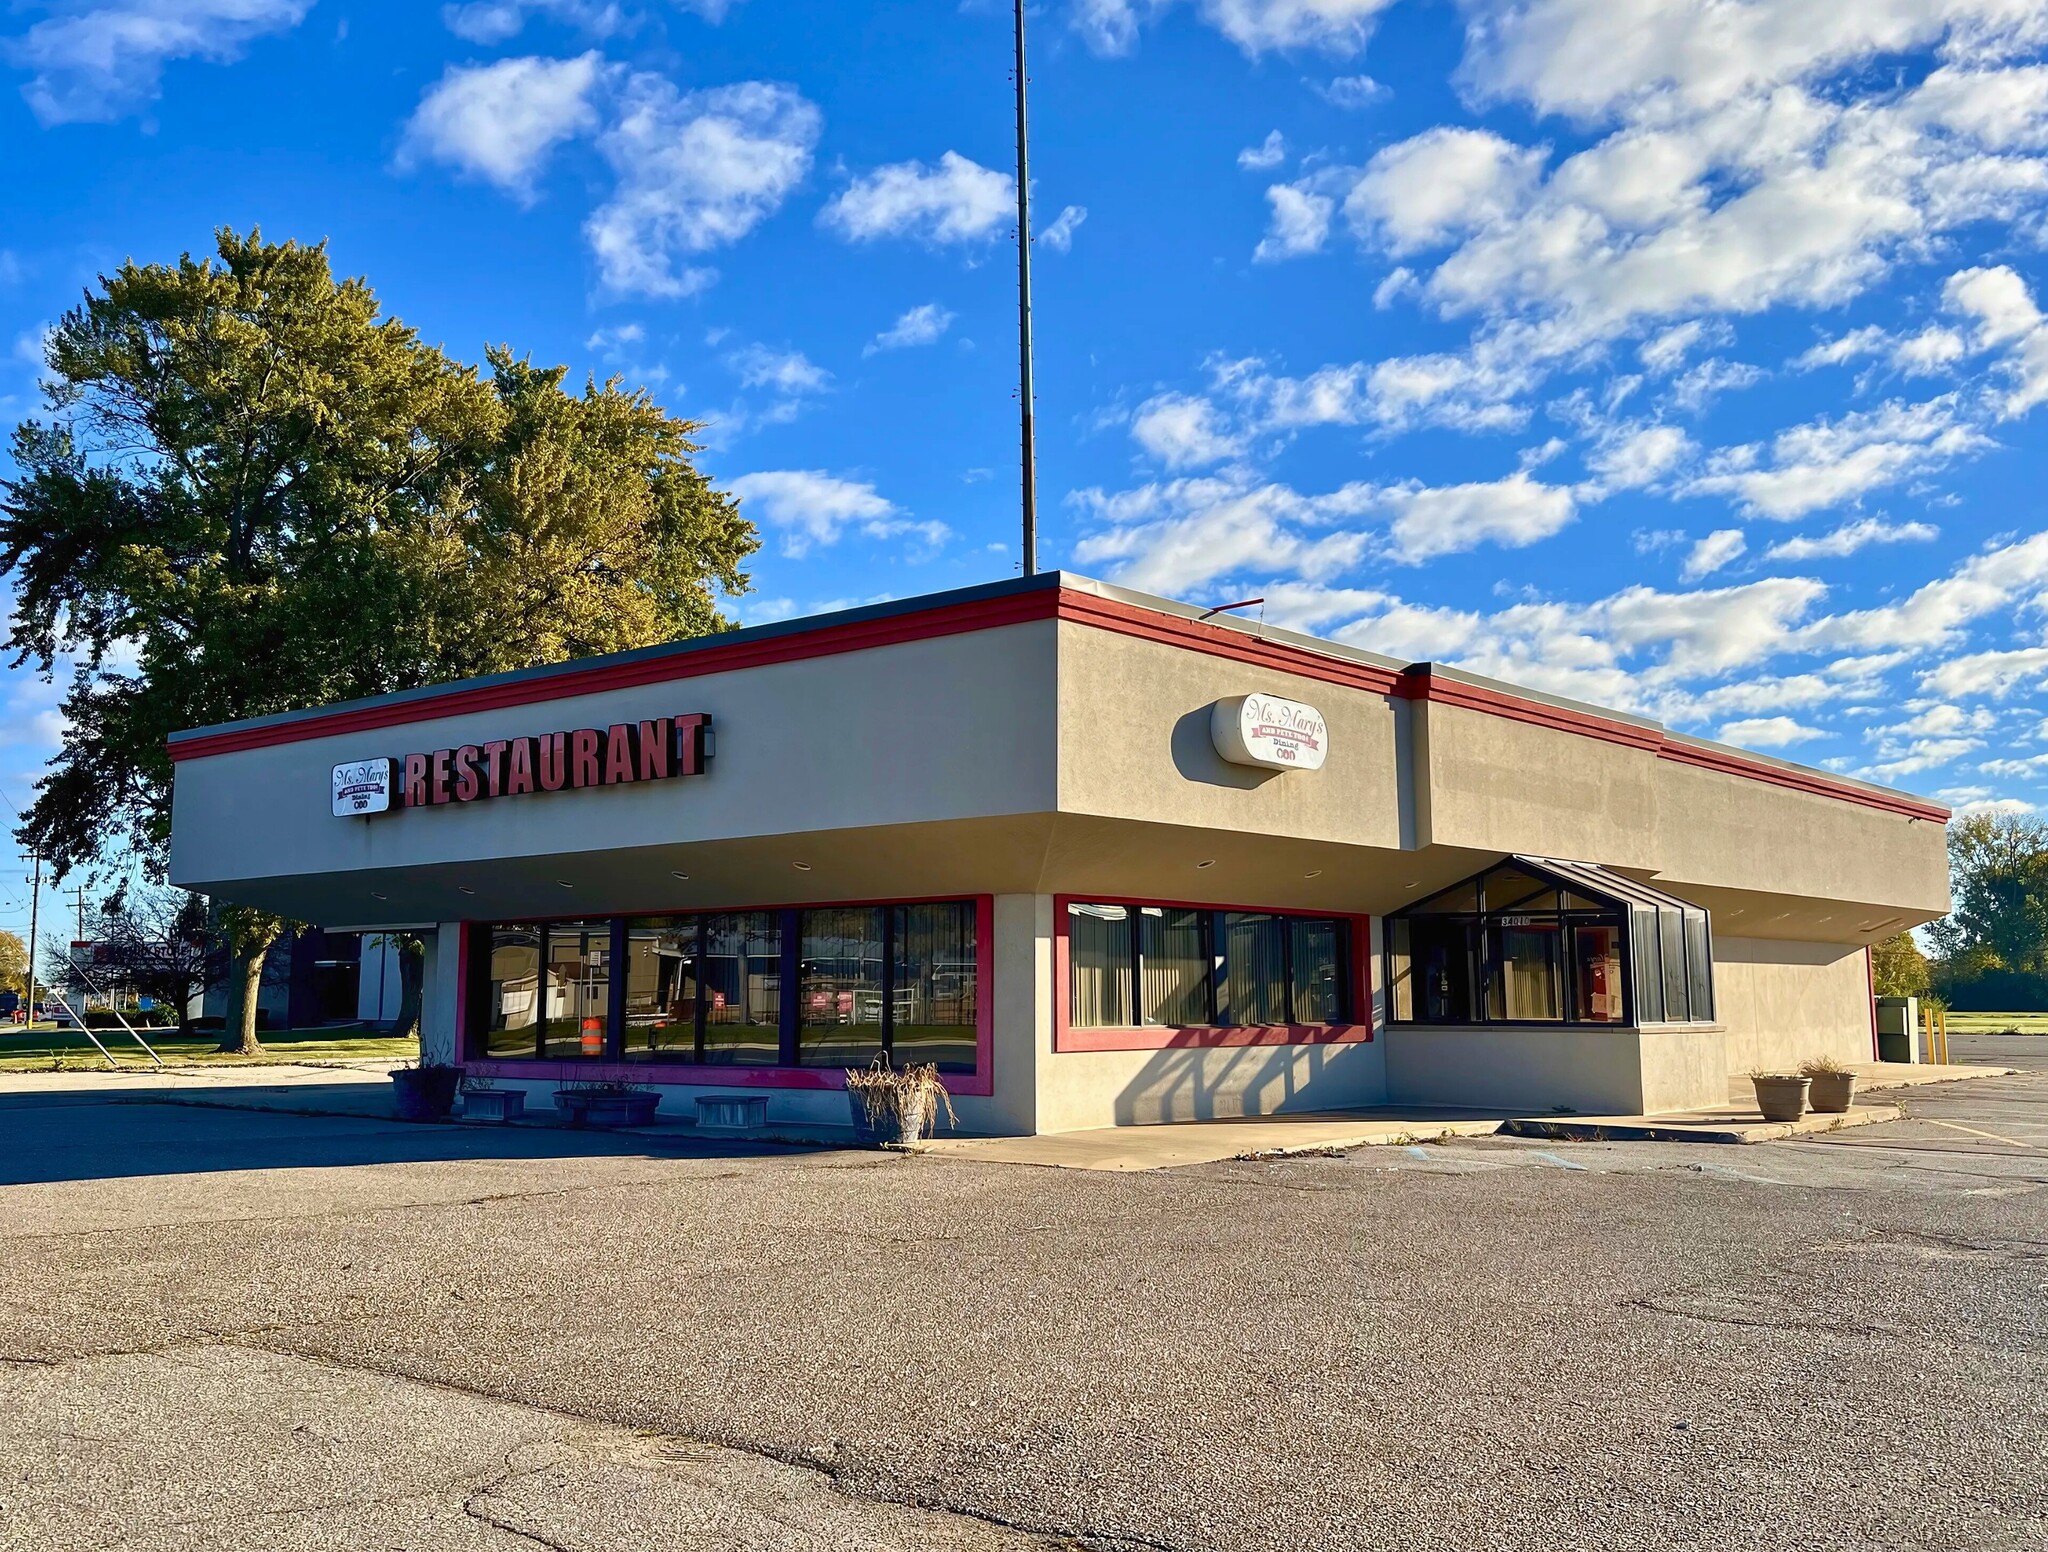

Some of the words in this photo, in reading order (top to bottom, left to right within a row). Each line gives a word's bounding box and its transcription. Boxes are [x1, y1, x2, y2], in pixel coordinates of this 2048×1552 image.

[1246, 699, 1275, 723] Ms.
[1279, 706, 1323, 737] Mary's
[1273, 738, 1299, 751] Dining
[404, 713, 711, 807] RESTAURANT
[334, 770, 353, 787] Ms.
[356, 765, 388, 785] Mary's
